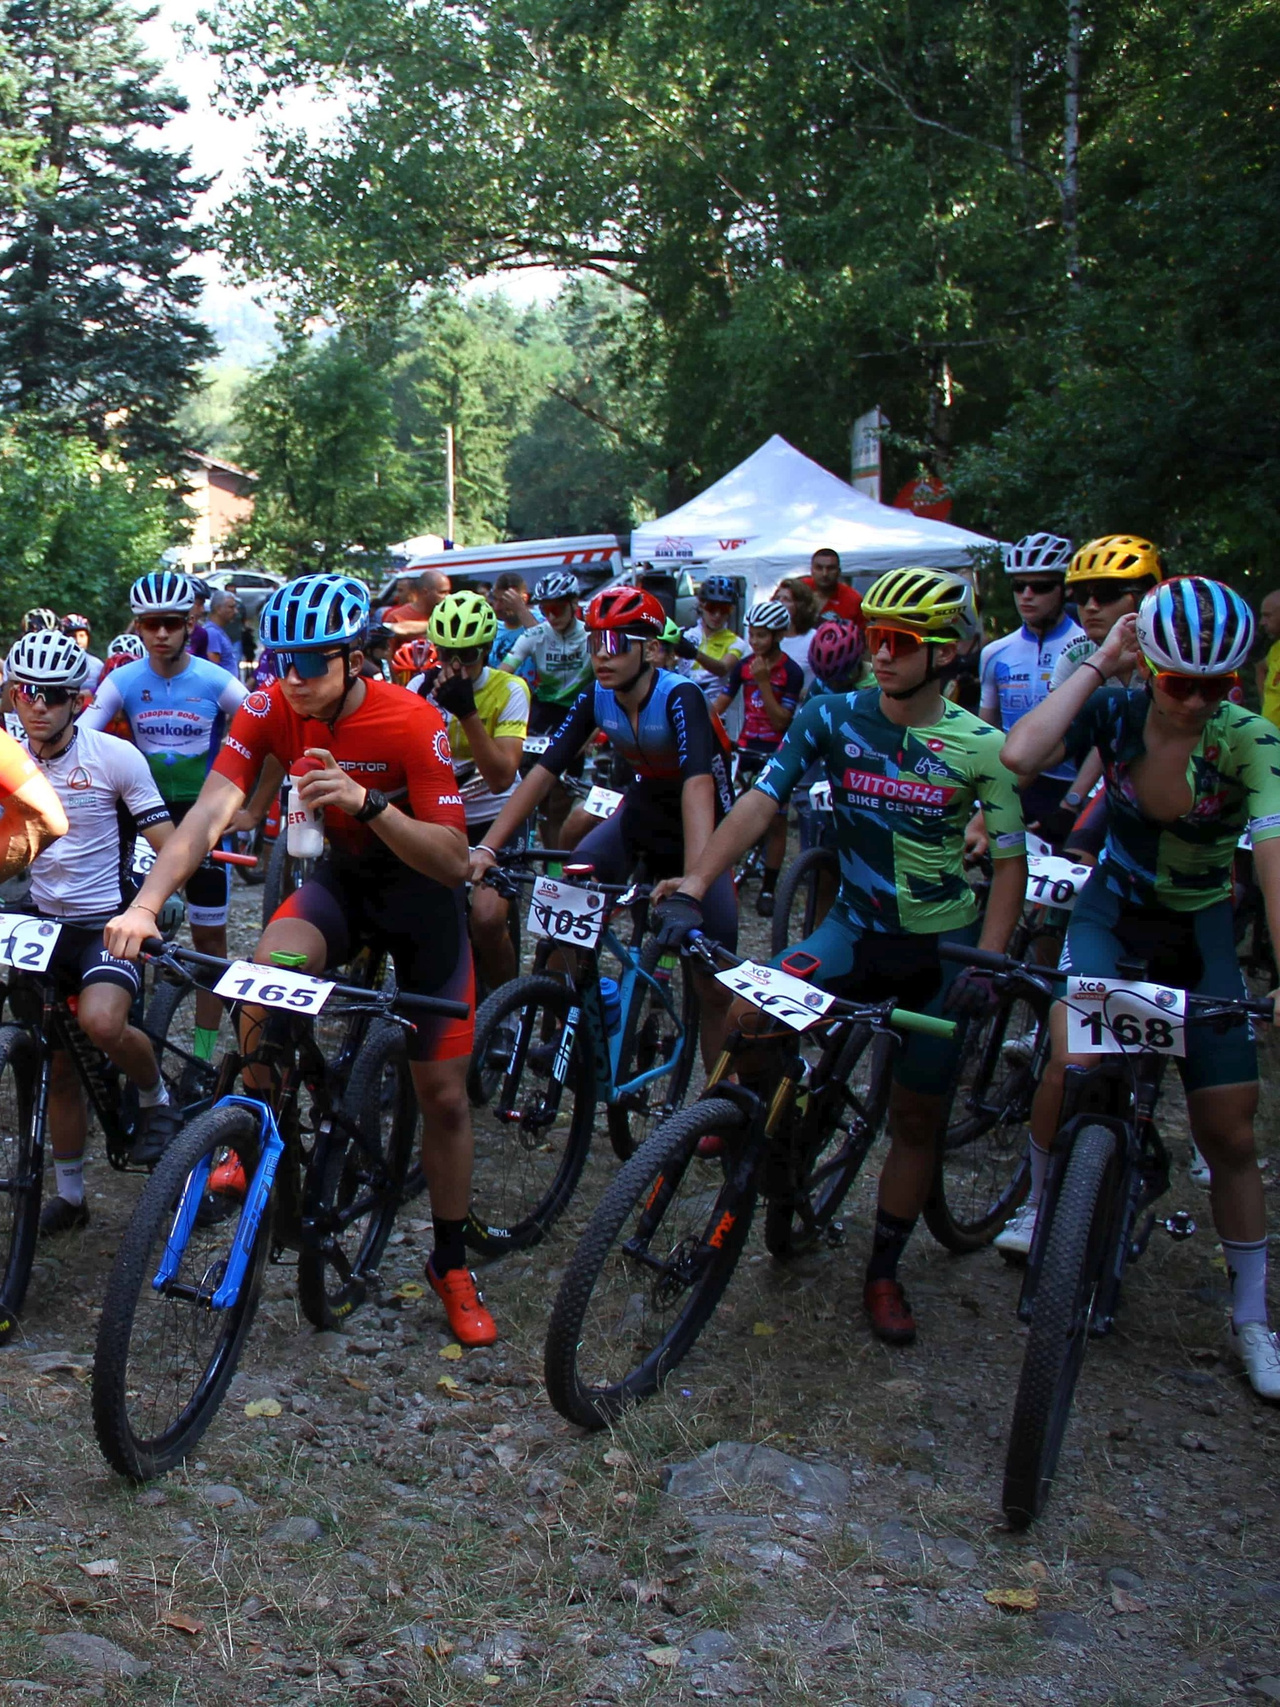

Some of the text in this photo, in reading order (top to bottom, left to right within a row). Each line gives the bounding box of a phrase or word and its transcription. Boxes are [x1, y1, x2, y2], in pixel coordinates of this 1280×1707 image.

[935, 606, 967, 615] SCOTT
[177, 711, 201, 722] вода
[336, 761, 388, 772] APTOR
[849, 772, 944, 804] VITOSHA
[847, 793, 880, 809] BIKE
[538, 905, 594, 941] 105
[233, 978, 318, 1007] 165
[1080, 1010, 1174, 1049] 168
